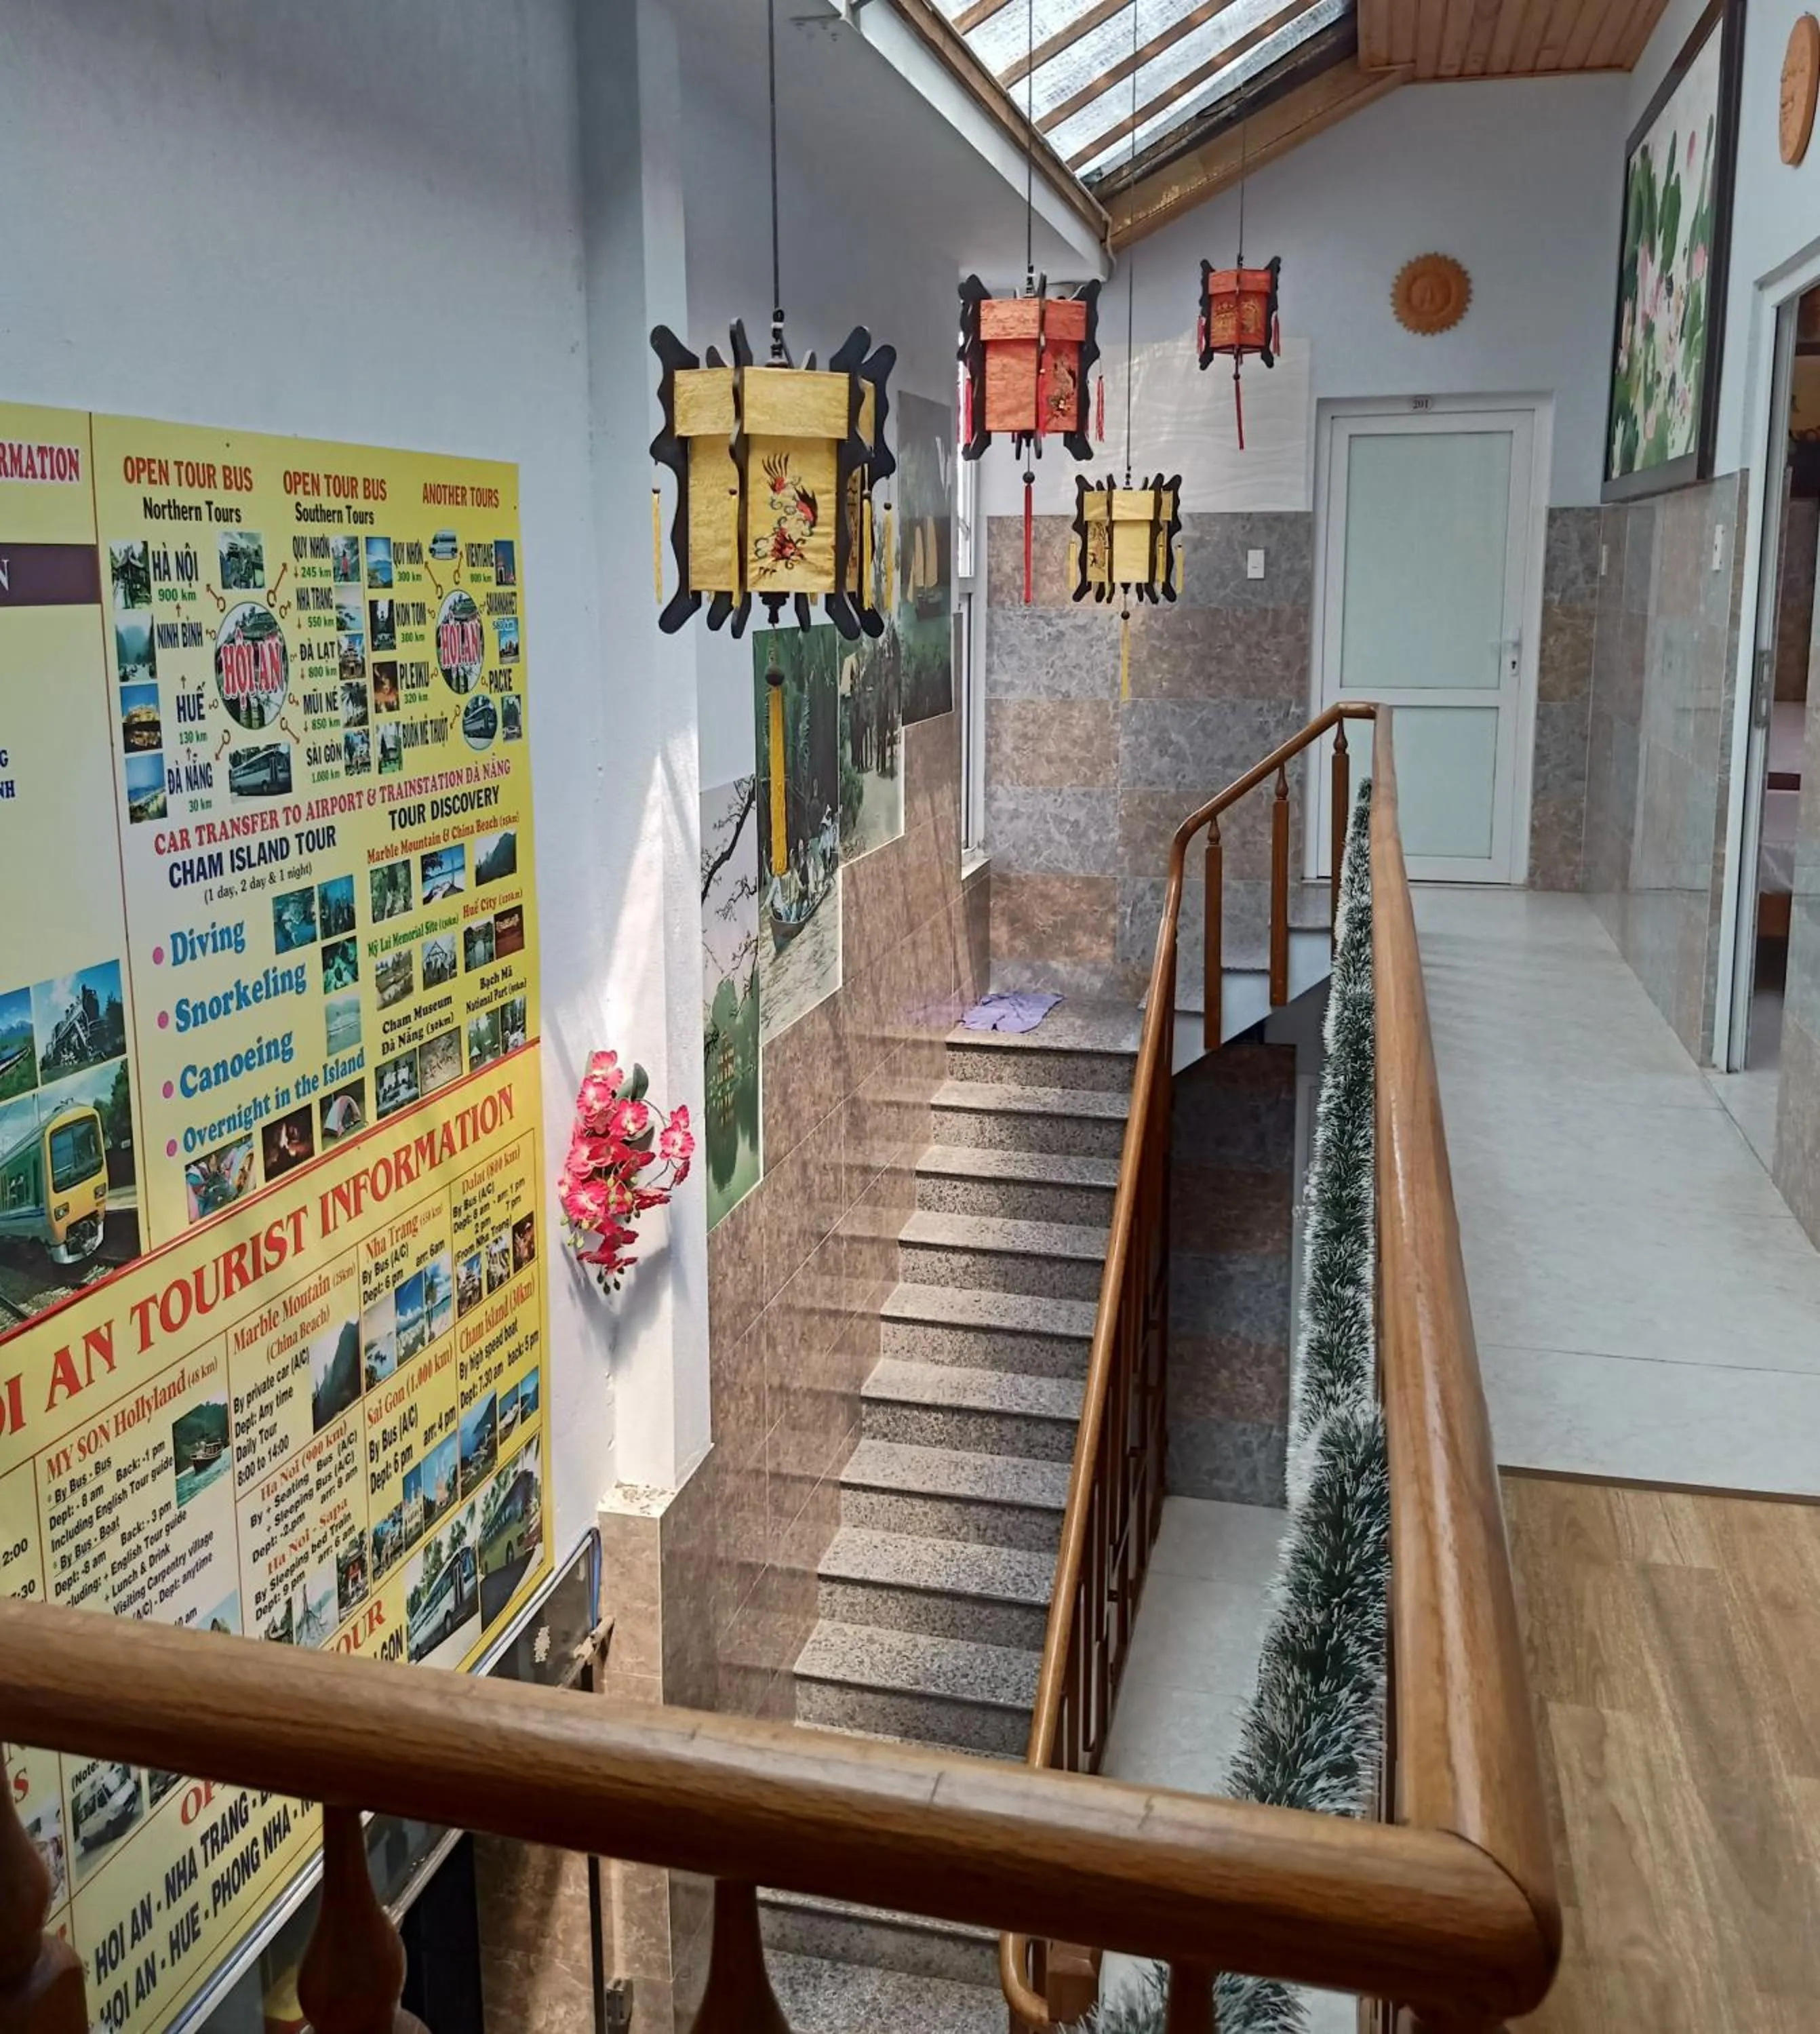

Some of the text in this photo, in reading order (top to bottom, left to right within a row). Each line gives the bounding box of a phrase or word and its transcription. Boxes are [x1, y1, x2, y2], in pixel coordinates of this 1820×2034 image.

[123, 456, 254, 492] OPEN TOUR BUS
[283, 471, 387, 500] OPEN TOUR BUS
[422, 483, 499, 508] ANOTHER TOURS
[143, 497, 242, 523] Northern Tours
[296, 502, 374, 525] Southern Tours
[151, 542, 199, 588] HÀ NỘI
[301, 567, 332, 578] 245 km
[158, 589, 196, 601] 900 km
[311, 587, 332, 610] TRANG
[157, 624, 180, 650] NINH
[308, 616, 334, 628] 550 km
[258, 639, 283, 693] AN
[300, 638, 314, 660] ĐÀ
[325, 667, 337, 677] km
[176, 681, 205, 723] HUẾ
[329, 719, 340, 727] km
[179, 731, 207, 744] 130 km
[167, 761, 182, 795] ĐÀ
[155, 769, 463, 855] CAR TRANSFER TO AIRPORT & TRAINSTATION
[189, 799, 212, 812] 30 km
[388, 785, 499, 831] TOUR DISCOVERY
[170, 825, 336, 888] CHAM ISLAND TOUR
[368, 816, 498, 864] Marble Mountain China Beach
[241, 862, 313, 892] 2 day 1 night)
[170, 920, 245, 967] Diving
[176, 963, 306, 1033] Snorkeling
[382, 995, 452, 1035] Cham Museum
[180, 1031, 294, 1098] Canoeing
[182, 1046, 365, 1153] Overnight in the Island
[45, 1083, 515, 1413] AN TOURIST INFORMATION
[366, 1215, 418, 1260] Nha Trang
[362, 1259, 389, 1285] By Bus
[384, 1269, 403, 1288] 6 pm
[233, 1275, 330, 1355] Marble Moutain
[267, 1304, 330, 1364] (China Beach)
[485, 1335, 503, 1359] speed
[233, 1347, 309, 1414] By private car (A/C)
[47, 1356, 218, 1484] MY SON Hollyland km)
[259, 1387, 294, 1421] Any time
[367, 1384, 404, 1427] Sai Gon
[237, 1422, 277, 1462] Daily Tour
[326, 1420, 347, 1448] km)
[369, 1403, 418, 1464] By Bus (A/C)
[371, 1406, 456, 1492] Dept: 6 pm pm
[50, 1441, 165, 1530] Dept: am Back: pm
[55, 1458, 111, 1504] By Bus Bus
[258, 1456, 266, 1471] to
[275, 1454, 333, 1508] Seating Bus
[52, 1456, 173, 1553] Including English Tour guide
[250, 1510, 263, 1528] By
[275, 1473, 332, 1526] Sleeping Bus
[55, 1501, 171, 1597] Dept: am Back: pm
[60, 1516, 120, 1570] By Bus Boat
[111, 1510, 186, 1576] English Tour guide
[255, 1512, 351, 1606] By Sleeping bed Train
[291, 1524, 355, 1591] pm am
[112, 1543, 170, 1597] Lunch Drink
[113, 1530, 214, 1616] Visiting Carpentry village
[159, 1553, 212, 1603] Dept: anytime
[330, 1600, 386, 1654] OUR
[94, 1791, 249, 1986] HOI AN NHA TRANG
[136, 1955, 157, 2009] AN
[169, 1901, 200, 1966] HUE
[212, 1842, 260, 1918] PHONG
[263, 1803, 291, 1860] NHA
